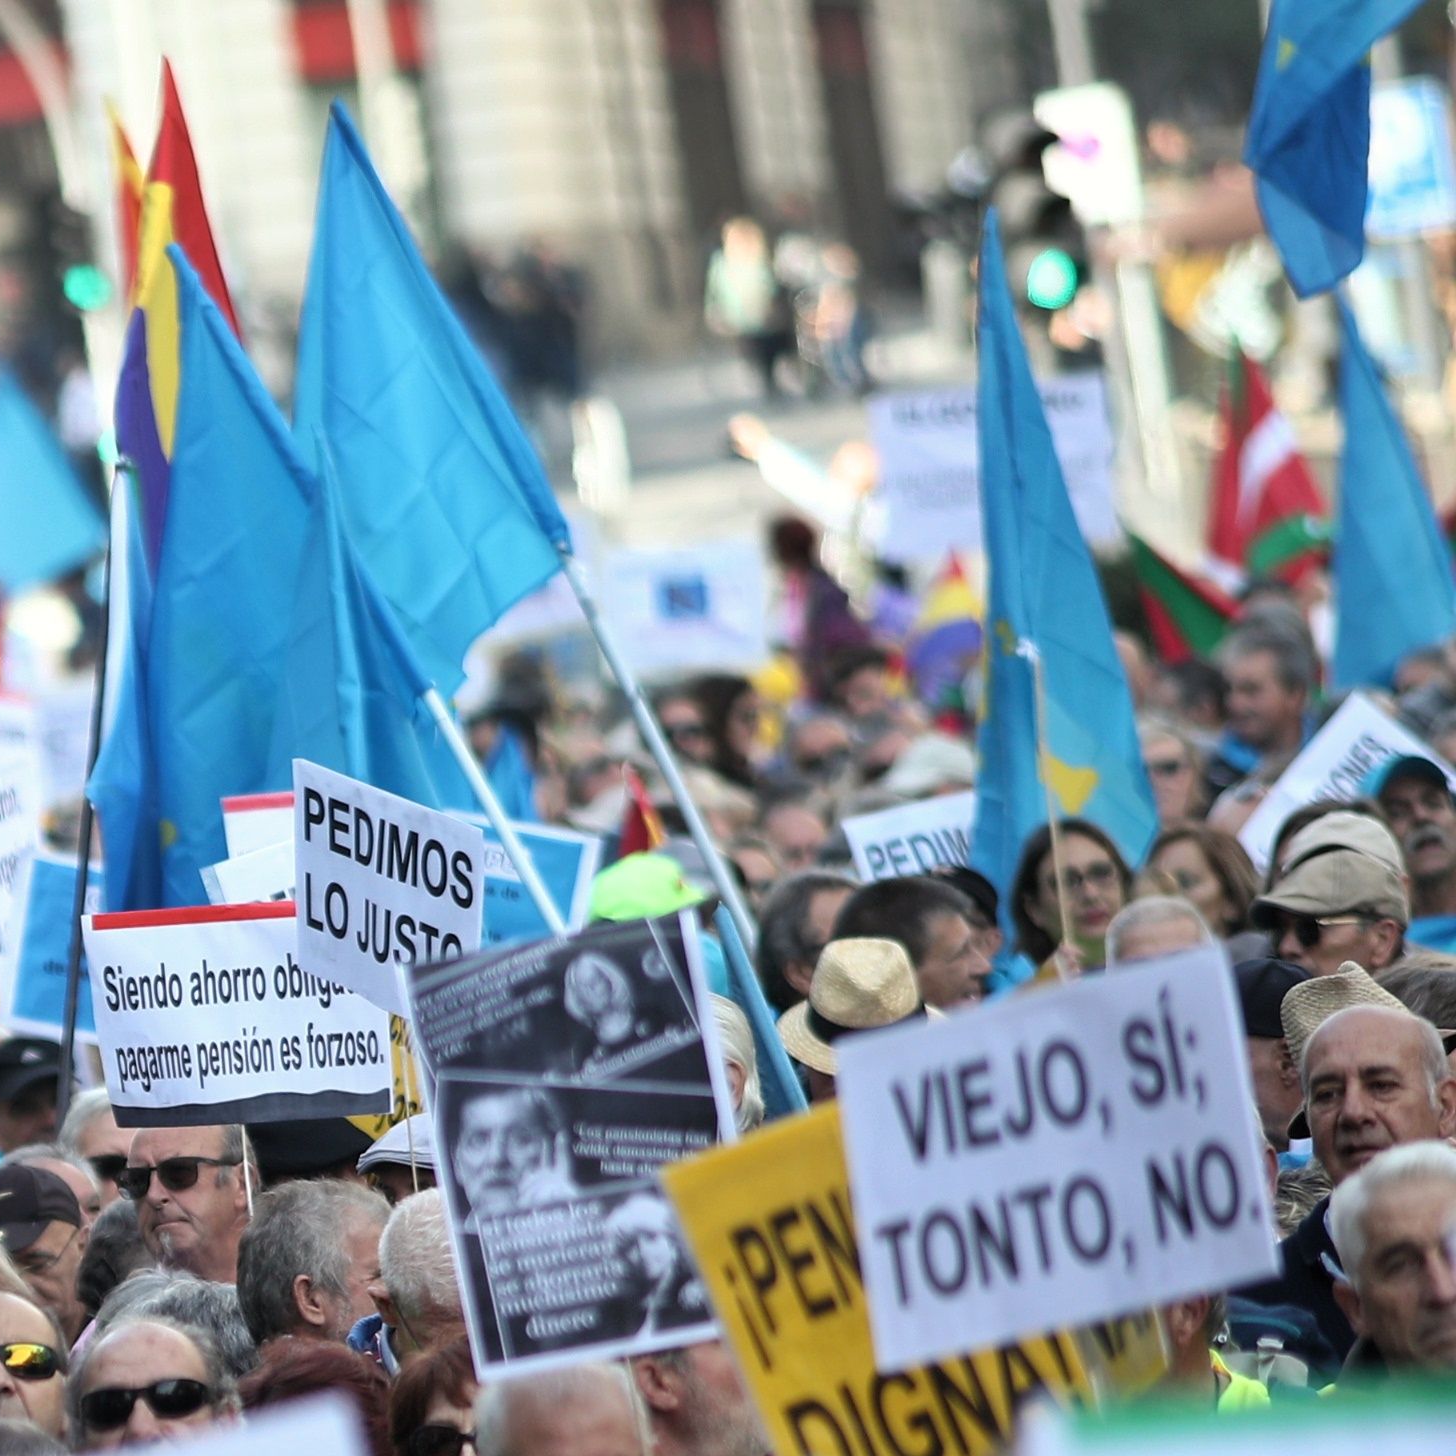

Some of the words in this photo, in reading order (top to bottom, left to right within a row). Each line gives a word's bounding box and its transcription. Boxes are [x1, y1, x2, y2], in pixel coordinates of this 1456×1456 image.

[303, 786, 474, 909] PEDIMOS
[305, 872, 349, 940] LO
[103, 962, 183, 1012] Siendo
[190, 958, 266, 1007] ahorro
[115, 1041, 192, 1092] pagarme
[196, 1026, 275, 1090] pensión
[280, 1034, 303, 1070] es
[306, 1022, 385, 1068] forzoso.
[891, 1037, 1112, 1166] VIEJO,
[1121, 982, 1207, 1114] SÍ;
[875, 1174, 1136, 1310] TONTO,
[1145, 1140, 1264, 1249] NO.
